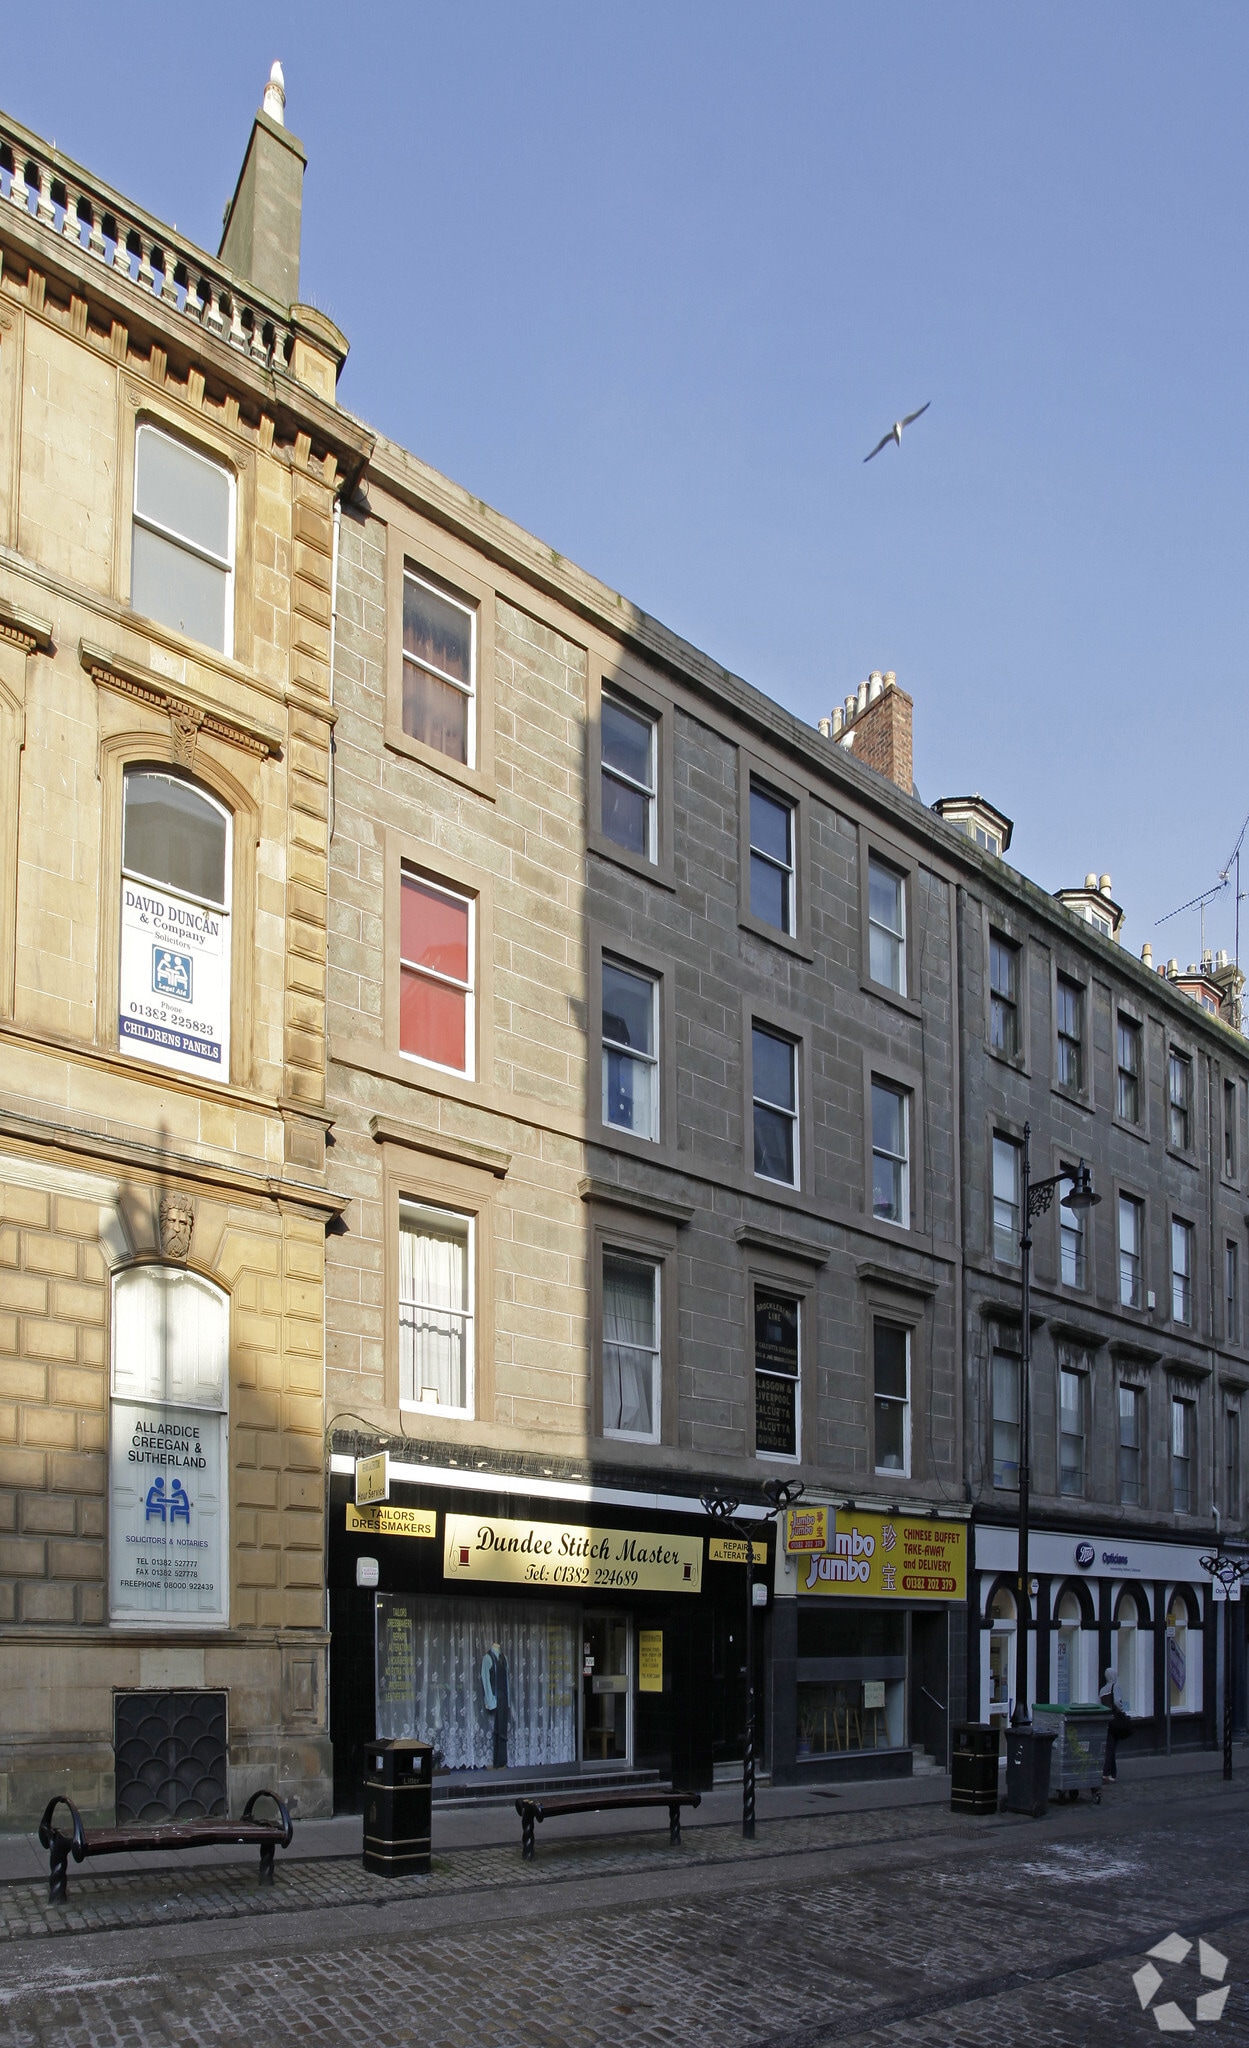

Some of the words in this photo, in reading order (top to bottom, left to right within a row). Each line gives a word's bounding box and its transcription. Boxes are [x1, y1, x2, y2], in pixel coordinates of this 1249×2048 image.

[125, 891, 165, 917] DAVID
[168, 906, 219, 937] DUNCAN
[139, 912, 149, 924] &
[153, 917, 206, 945] Company
[154, 931, 191, 950] Solicitors
[158, 983, 174, 994] Legal
[175, 986, 187, 997] Aid
[160, 1001, 183, 1014] Phone
[130, 1001, 167, 1022] 01382
[170, 1012, 214, 1036] 225823
[123, 1021, 181, 1048] CHILDRENS
[182, 1037, 219, 1059] PANELS
[756, 1379, 785, 1393] LASGOW
[786, 1384, 792, 1394] &
[135, 1421, 200, 1439] ALLARDICE
[132, 1435, 189, 1453] CREEGAN
[194, 1442, 202, 1454] &
[758, 1434, 788, 1448] DUNDEE
[128, 1450, 207, 1469] SUTHERLAND
[368, 1487, 385, 1499] Service
[370, 1508, 415, 1522] TAILORS
[790, 1511, 816, 1529] Jumbo
[352, 1518, 432, 1534] DRESSMAKERS
[125, 1535, 167, 1546] SOLICITORS
[168, 1537, 174, 1546] &
[176, 1538, 209, 1548] NOTARIES
[835, 1527, 876, 1558] mbo
[903, 1528, 932, 1542] CHINESE
[934, 1531, 961, 1544] BUFFET
[475, 1525, 553, 1555] Dundee
[558, 1532, 611, 1560] Stitch
[615, 1538, 680, 1566] Master
[723, 1541, 751, 1551] REPAIR
[903, 1543, 945, 1558] TAKE-AWAY
[136, 1557, 149, 1565] TEL
[151, 1558, 172, 1567] 01382
[174, 1559, 198, 1568] 527777
[713, 1550, 761, 1562] ALTERATINS
[1101, 1551, 1129, 1565] Opticians
[136, 1568, 149, 1576] FAX
[151, 1568, 172, 1577] 01382
[174, 1570, 198, 1578] 527778
[903, 1558, 916, 1570] and
[918, 1559, 952, 1573] DELIVERY
[524, 1563, 550, 1582] Tel:
[553, 1566, 590, 1584] 01382
[594, 1567, 639, 1587] 224689
[120, 1579, 161, 1589] FREEPHONE
[164, 1581, 187, 1590] 08000
[189, 1583, 214, 1591] 922439
[906, 1577, 925, 1589] 01382
[927, 1578, 939, 1590] 202
[941, 1579, 953, 1591] 379
[403, 1777, 420, 1785] Litter
